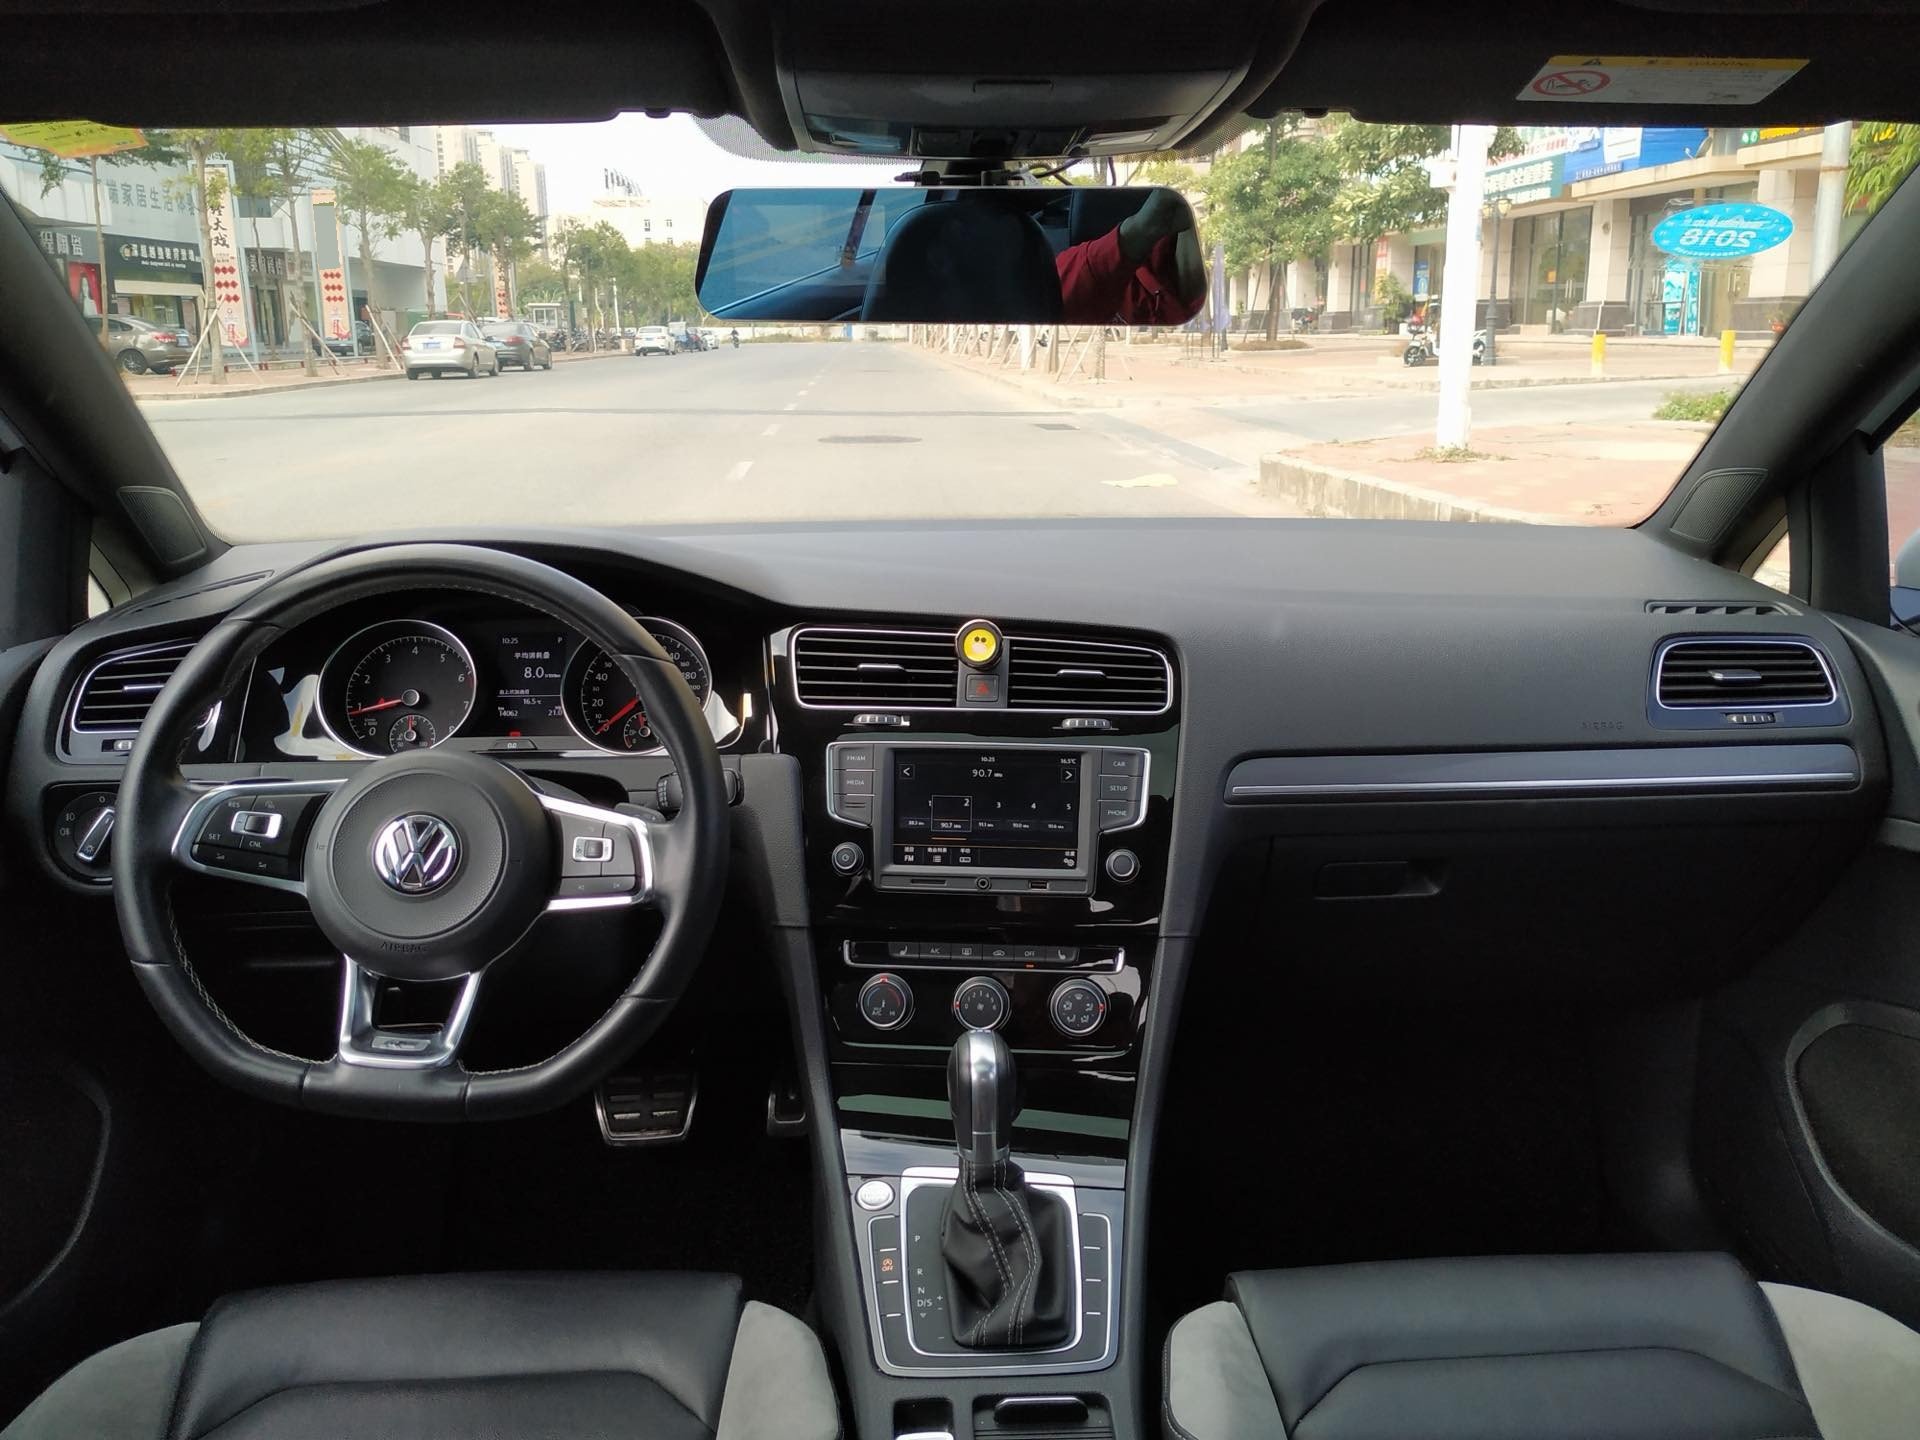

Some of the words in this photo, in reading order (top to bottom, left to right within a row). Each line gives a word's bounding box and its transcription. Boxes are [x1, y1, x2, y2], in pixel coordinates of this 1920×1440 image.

[411, 646, 418, 654] 4
[385, 655, 391, 664] 3
[439, 653, 446, 662] 5
[524, 666, 544, 678] 8.0
[364, 674, 370, 684] 2
[457, 673, 465, 682] 6
[595, 673, 608, 681] 40
[369, 727, 376, 736] 0
[972, 769, 992, 777] 90.7
[208, 833, 221, 841] SET
[917, 1299, 933, 1307] D/S
